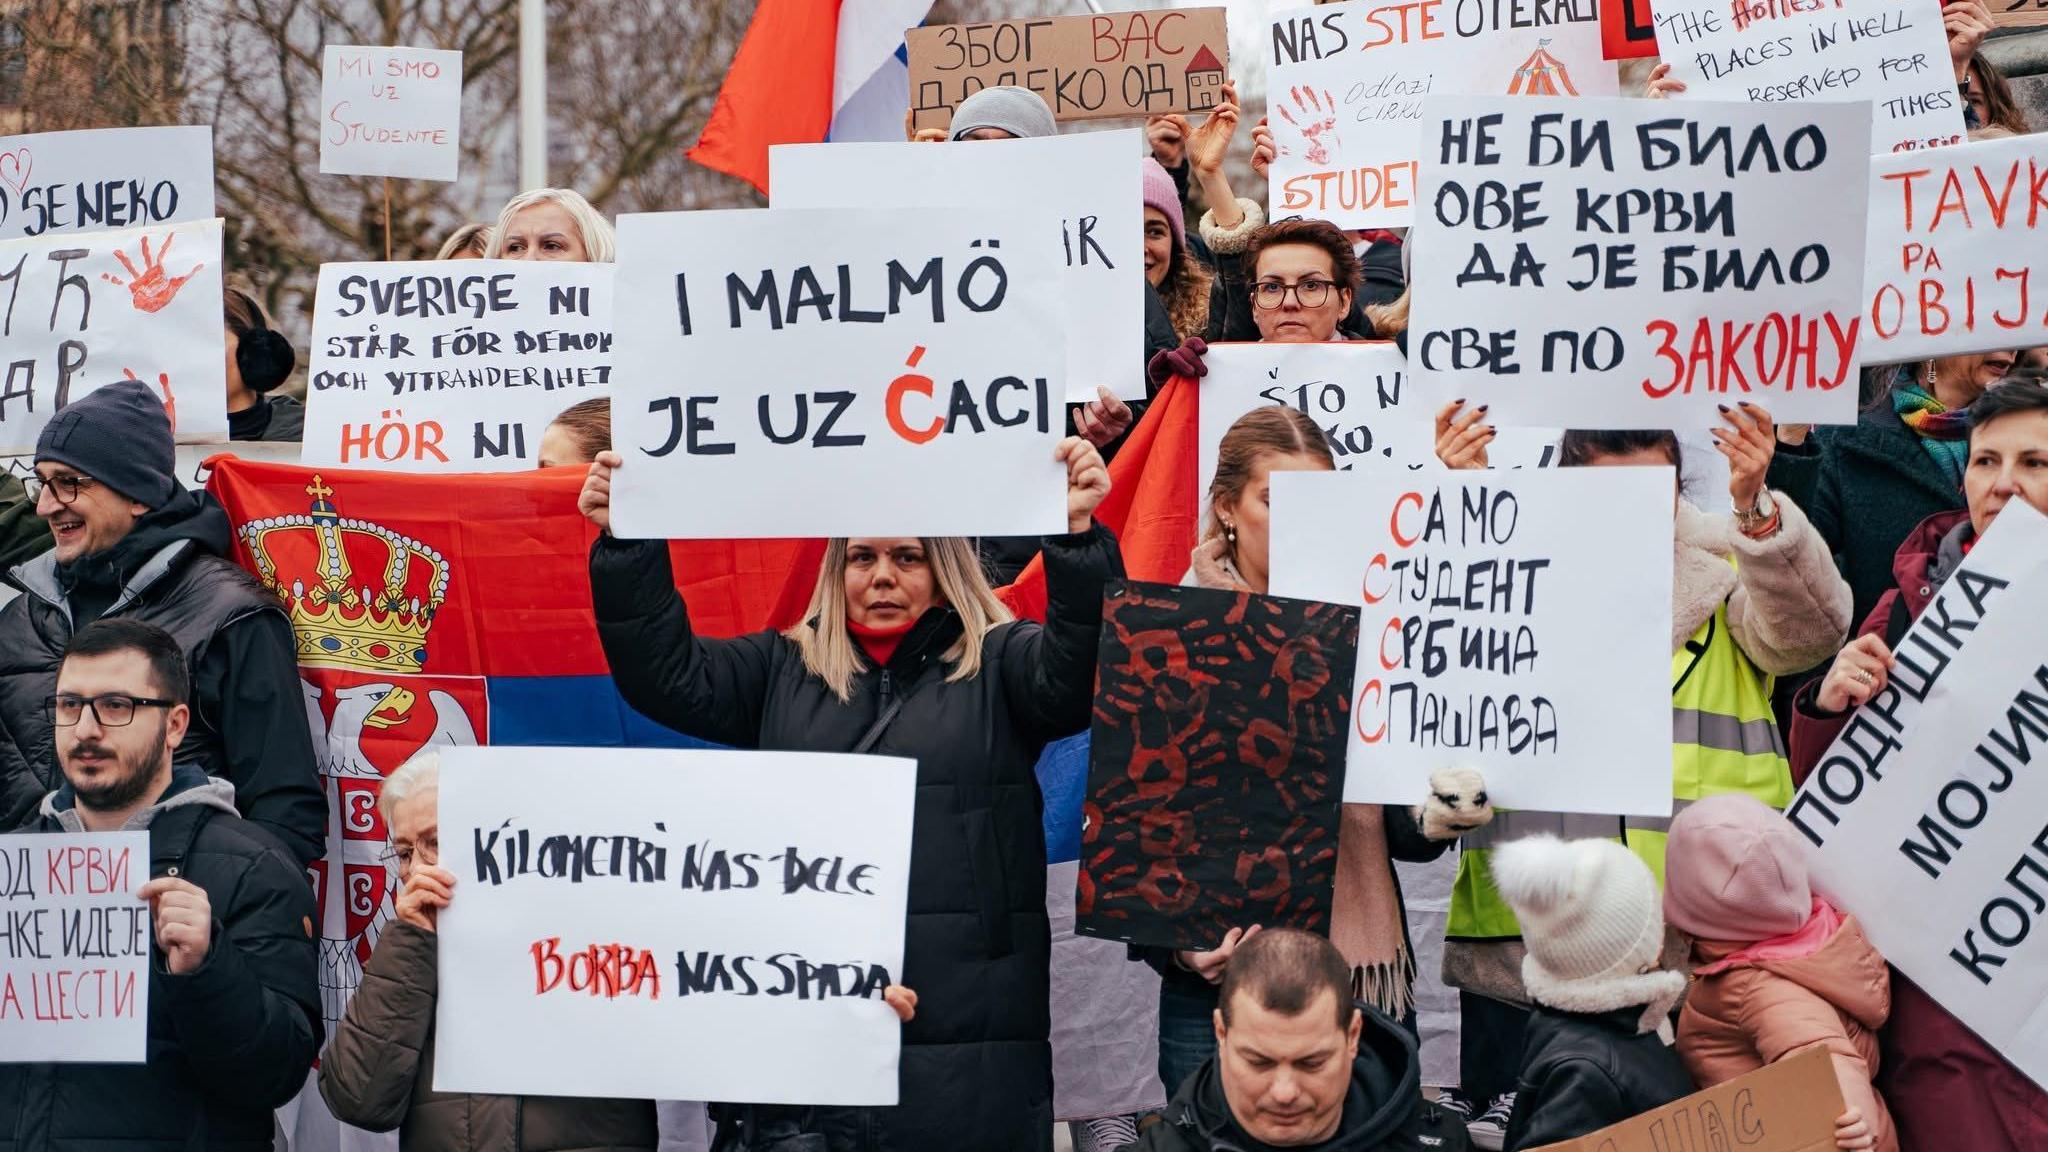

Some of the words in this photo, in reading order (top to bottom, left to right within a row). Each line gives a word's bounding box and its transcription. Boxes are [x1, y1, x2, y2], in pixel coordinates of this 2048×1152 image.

[935, 21, 1052, 70] ЗБОГ
[1092, 13, 1186, 63] ВАС
[1272, 12, 1349, 66] NAS
[1361, 0, 1445, 51] STE
[1696, 36, 1793, 81] PLACES
[1850, 10, 1913, 43] HELL
[338, 55, 372, 77] MI
[384, 58, 441, 79] SMO
[371, 84, 401, 100] UZ
[1122, 64, 1174, 111] ОД
[1747, 67, 1861, 102] RESERVED
[1879, 54, 1929, 81] FOR
[1881, 90, 1953, 119] TIMES
[1440, 113, 1504, 166] НЕ
[1527, 113, 1614, 173] БИ
[1635, 118, 1828, 179] БИЛО
[1434, 180, 1549, 232] ОВЕ
[1575, 187, 1735, 236] КРВИ
[675, 272, 693, 336] I
[726, 239, 1008, 331] MALMÖ
[1456, 242, 1547, 288] ДА
[1661, 242, 1831, 293] БИЛО
[335, 274, 519, 318] SVERIGE
[549, 286, 590, 316] NI
[1871, 267, 2048, 340] OBIJ
[327, 324, 415, 359] STÅR
[432, 326, 502, 358] FÖR
[1420, 326, 1521, 375] СВЕ
[1541, 327, 1625, 373] ПО
[1641, 310, 1861, 399] ЗАКОНУ
[313, 371, 368, 391] OCH
[640, 395, 736, 458] JE
[757, 391, 866, 447] UZ
[885, 345, 1050, 445] ĆACI
[340, 409, 449, 463] HÖR
[473, 422, 526, 459] NI
[1390, 486, 1519, 548] САМО
[1362, 553, 1550, 615] СТУДЕНТ
[1379, 615, 1539, 678] СРБИНА
[1356, 679, 1558, 756] СПАШАВА
[1786, 568, 2010, 849] ПОДРШКА
[47, 847, 130, 894] КРВИ
[61, 906, 147, 960] ИДЕЈЕ
[529, 936, 661, 1000] BORBA
[675, 951, 760, 997] NAS
[31, 970, 135, 1024] ЦЕСТИ
